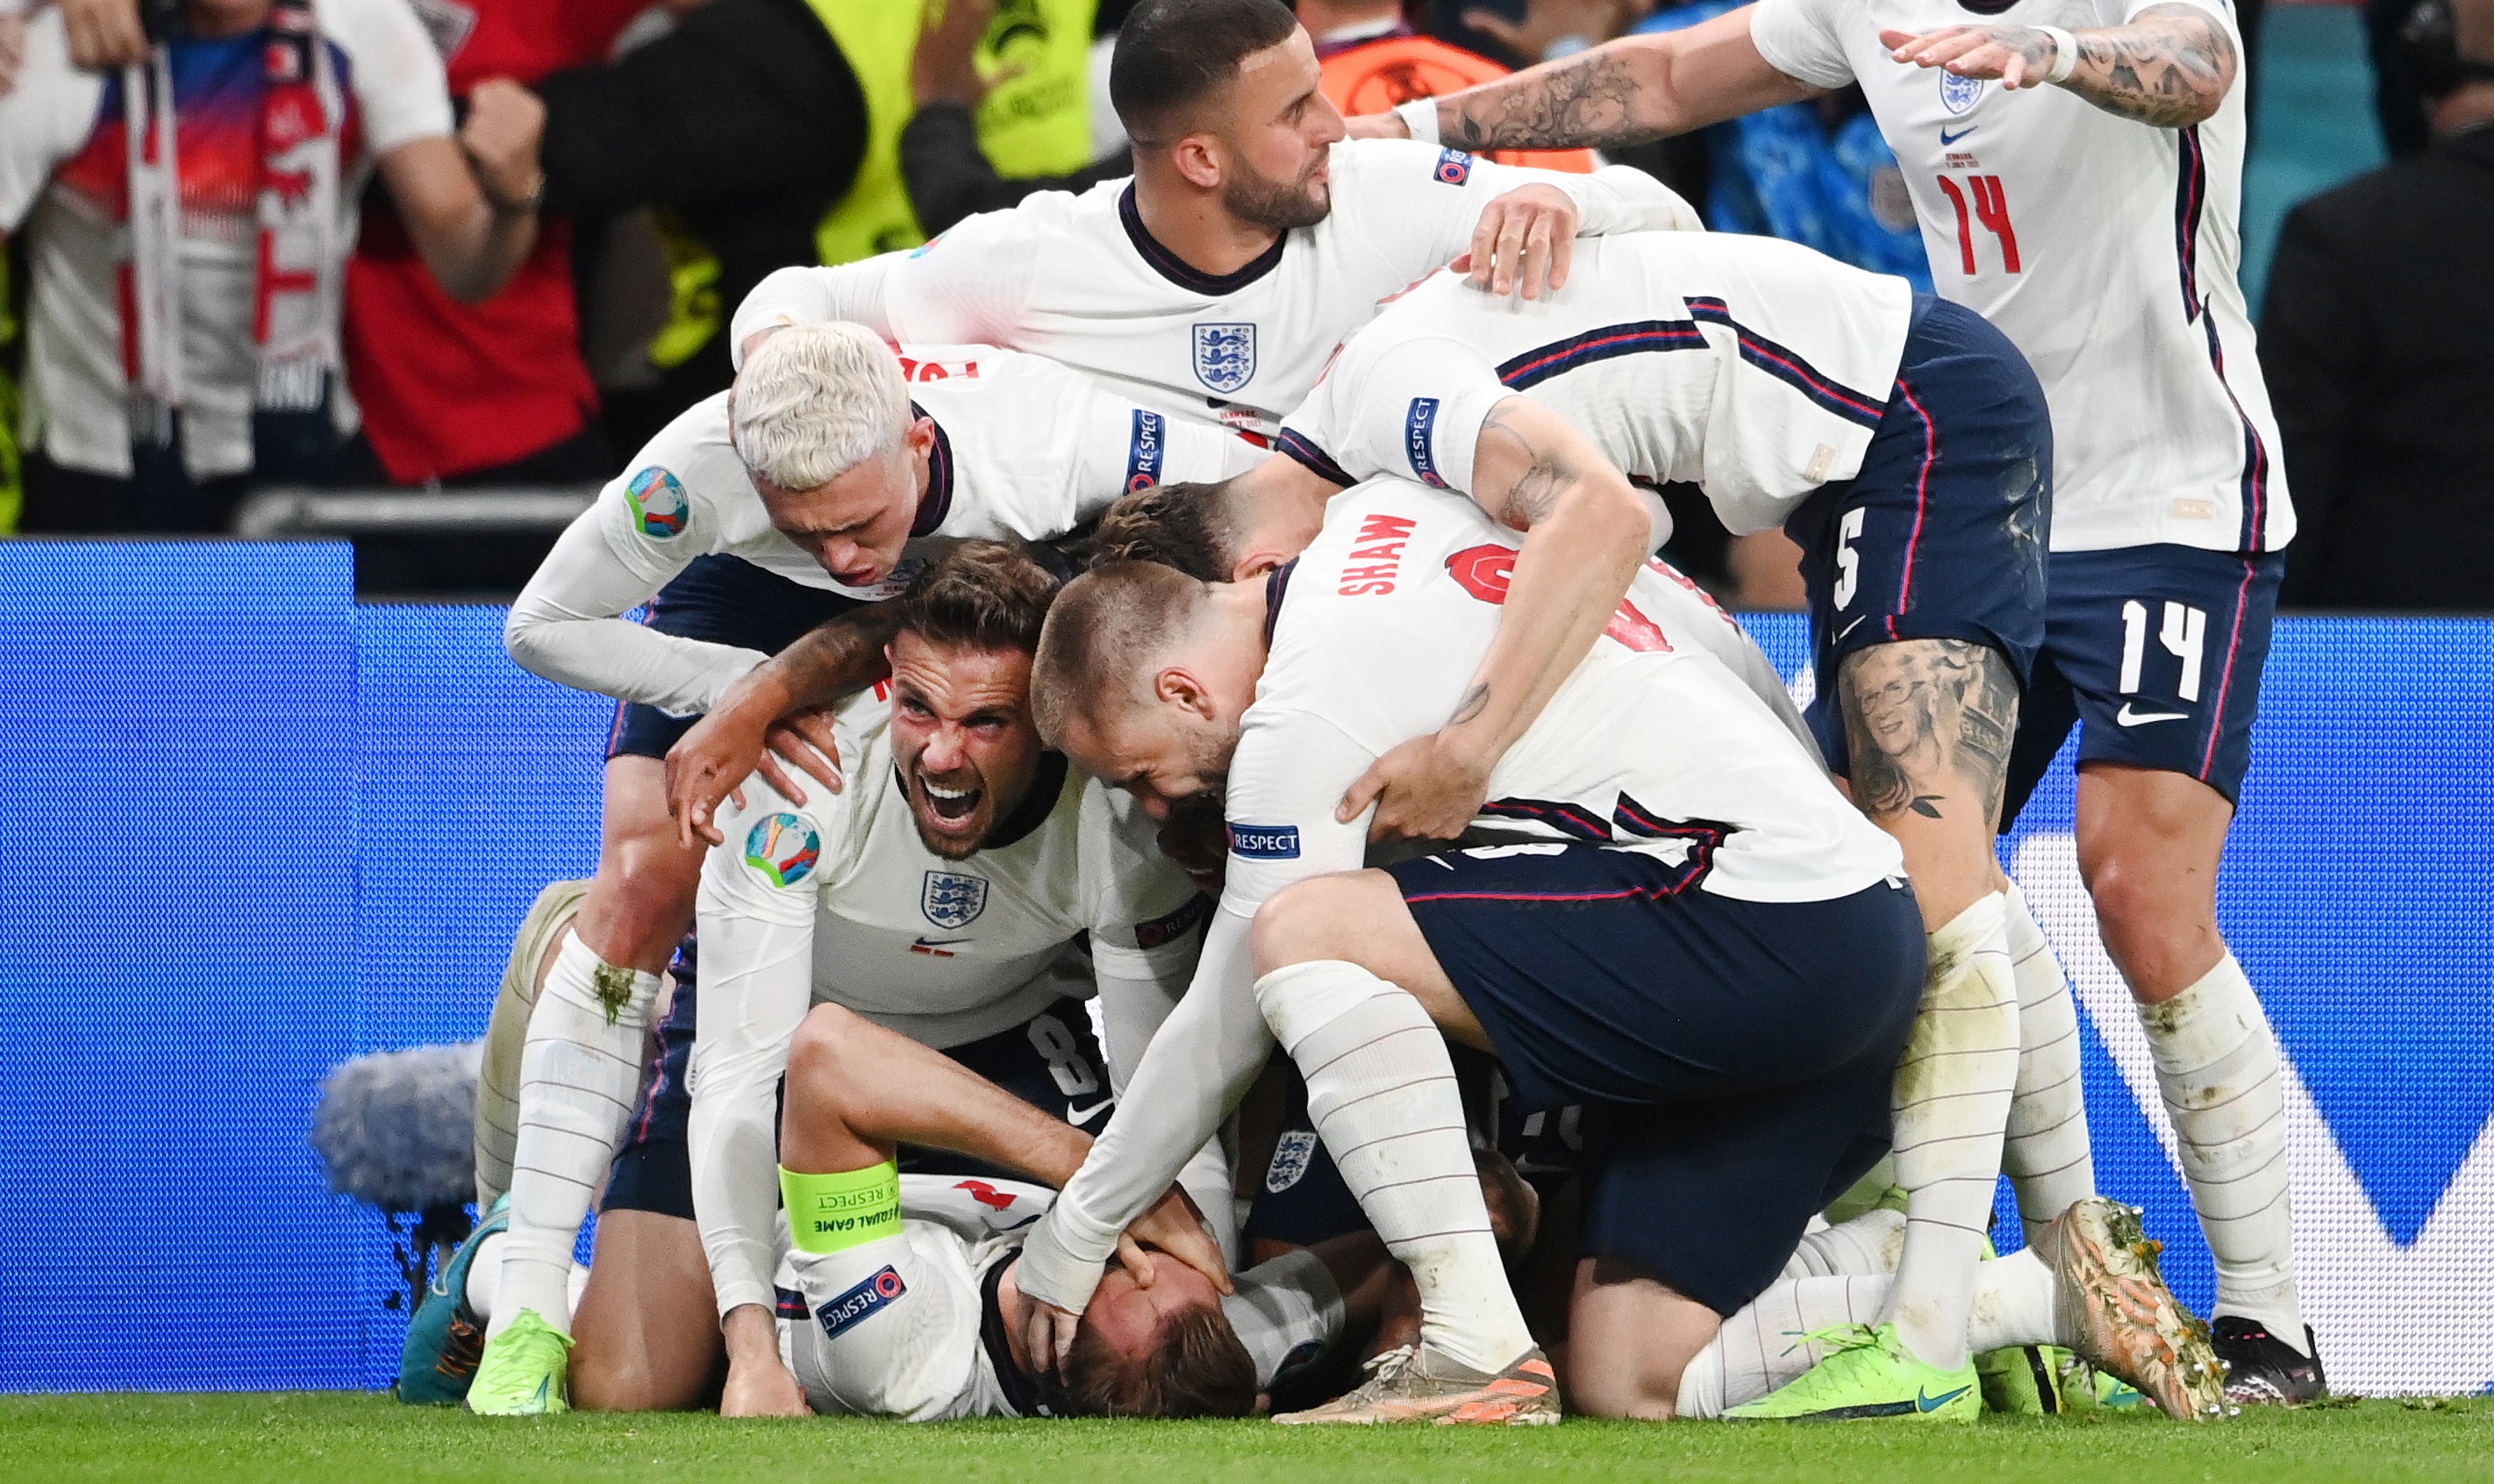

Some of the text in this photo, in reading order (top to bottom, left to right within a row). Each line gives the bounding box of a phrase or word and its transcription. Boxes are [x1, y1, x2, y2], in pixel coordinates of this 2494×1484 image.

[1937, 175, 2021, 275] 14
[1138, 410, 1156, 472] RESPECT
[1412, 399, 1432, 470] RESPECT
[1337, 514, 1418, 596] SHAW
[1833, 506, 1866, 612] 5
[2119, 600, 2207, 703] 14
[1234, 833, 1297, 851] RESPECT
[1027, 1014, 1099, 1097] 8
[813, 1216, 855, 1233] GAME
[818, 1187, 884, 1209] RESPECT
[821, 1287, 878, 1331] RESPECT
